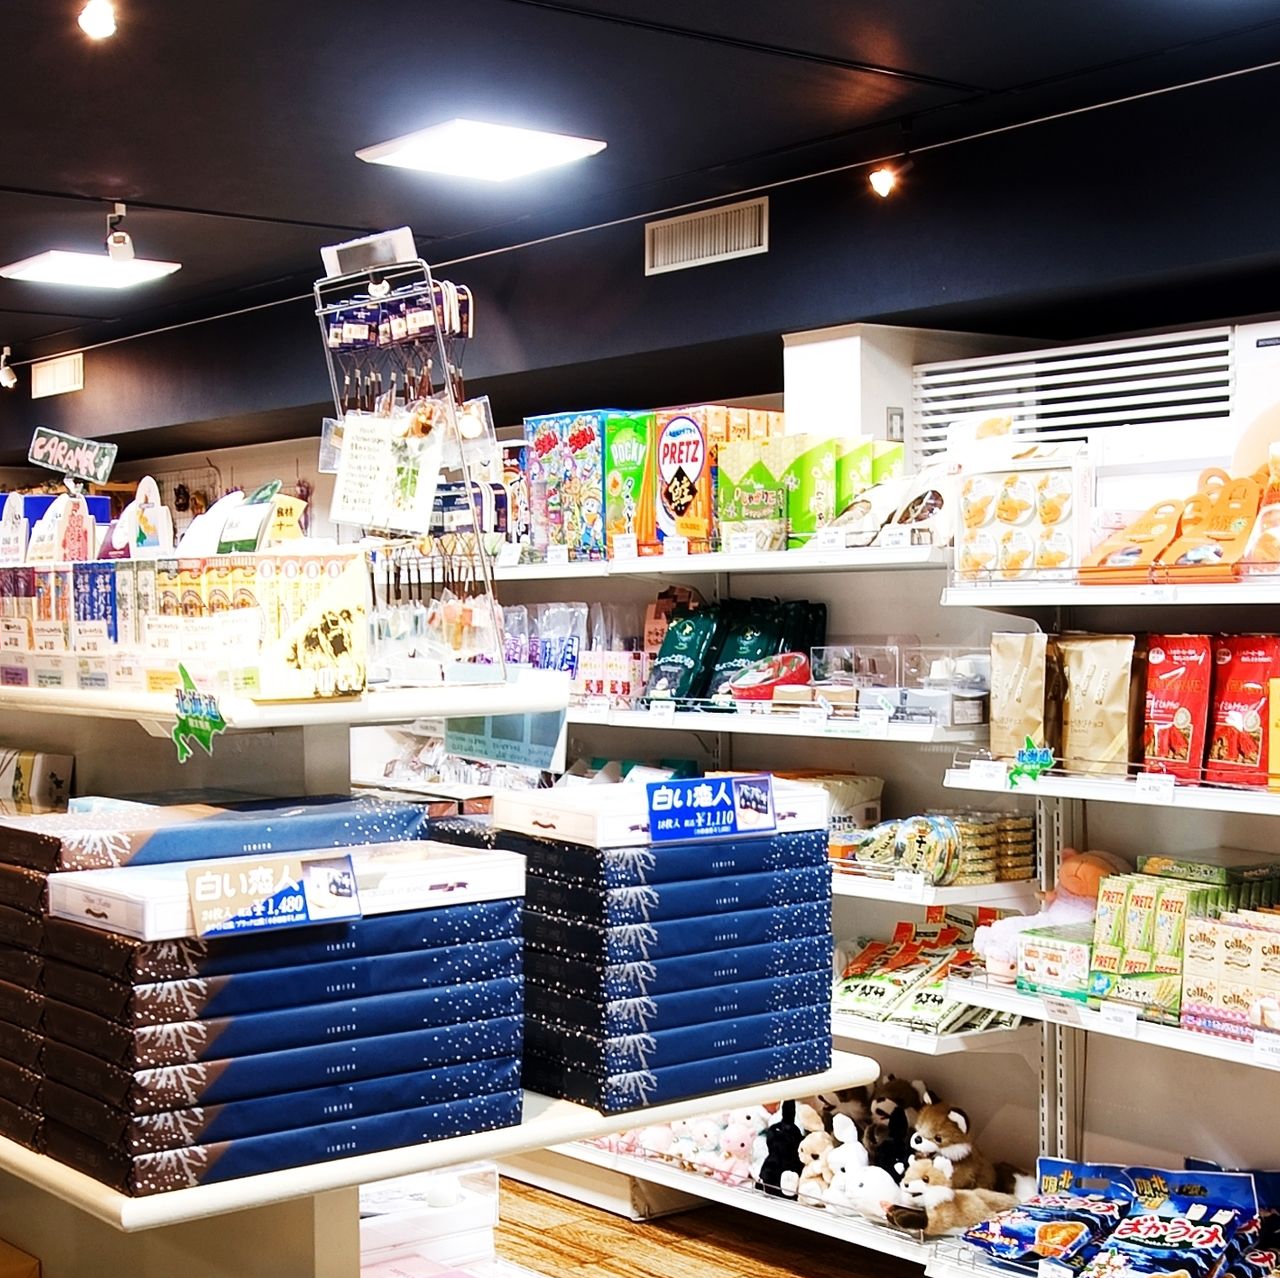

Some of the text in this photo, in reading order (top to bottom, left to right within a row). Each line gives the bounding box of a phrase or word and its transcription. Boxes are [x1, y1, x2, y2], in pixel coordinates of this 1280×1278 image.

[611, 441, 646, 467] POCKY
[662, 440, 699, 465] PRETZ
[668, 476, 692, 504] 鮭
[175, 688, 221, 720] 北海道
[652, 781, 731, 811] 白い恋人
[695, 810, 734, 827] ¥1,110
[195, 864, 301, 901] 白い恋人
[252, 894, 303, 917] ¥1,480
[1102, 890, 1125, 905] PRETZ
[1131, 893, 1154, 909] PRETZ
[1160, 898, 1185, 914] PRETZ
[1094, 953, 1118, 969] PRETZ
[1125, 959, 1148, 974] PRETZ
[1117, 1215, 1226, 1248] ばかうけ
